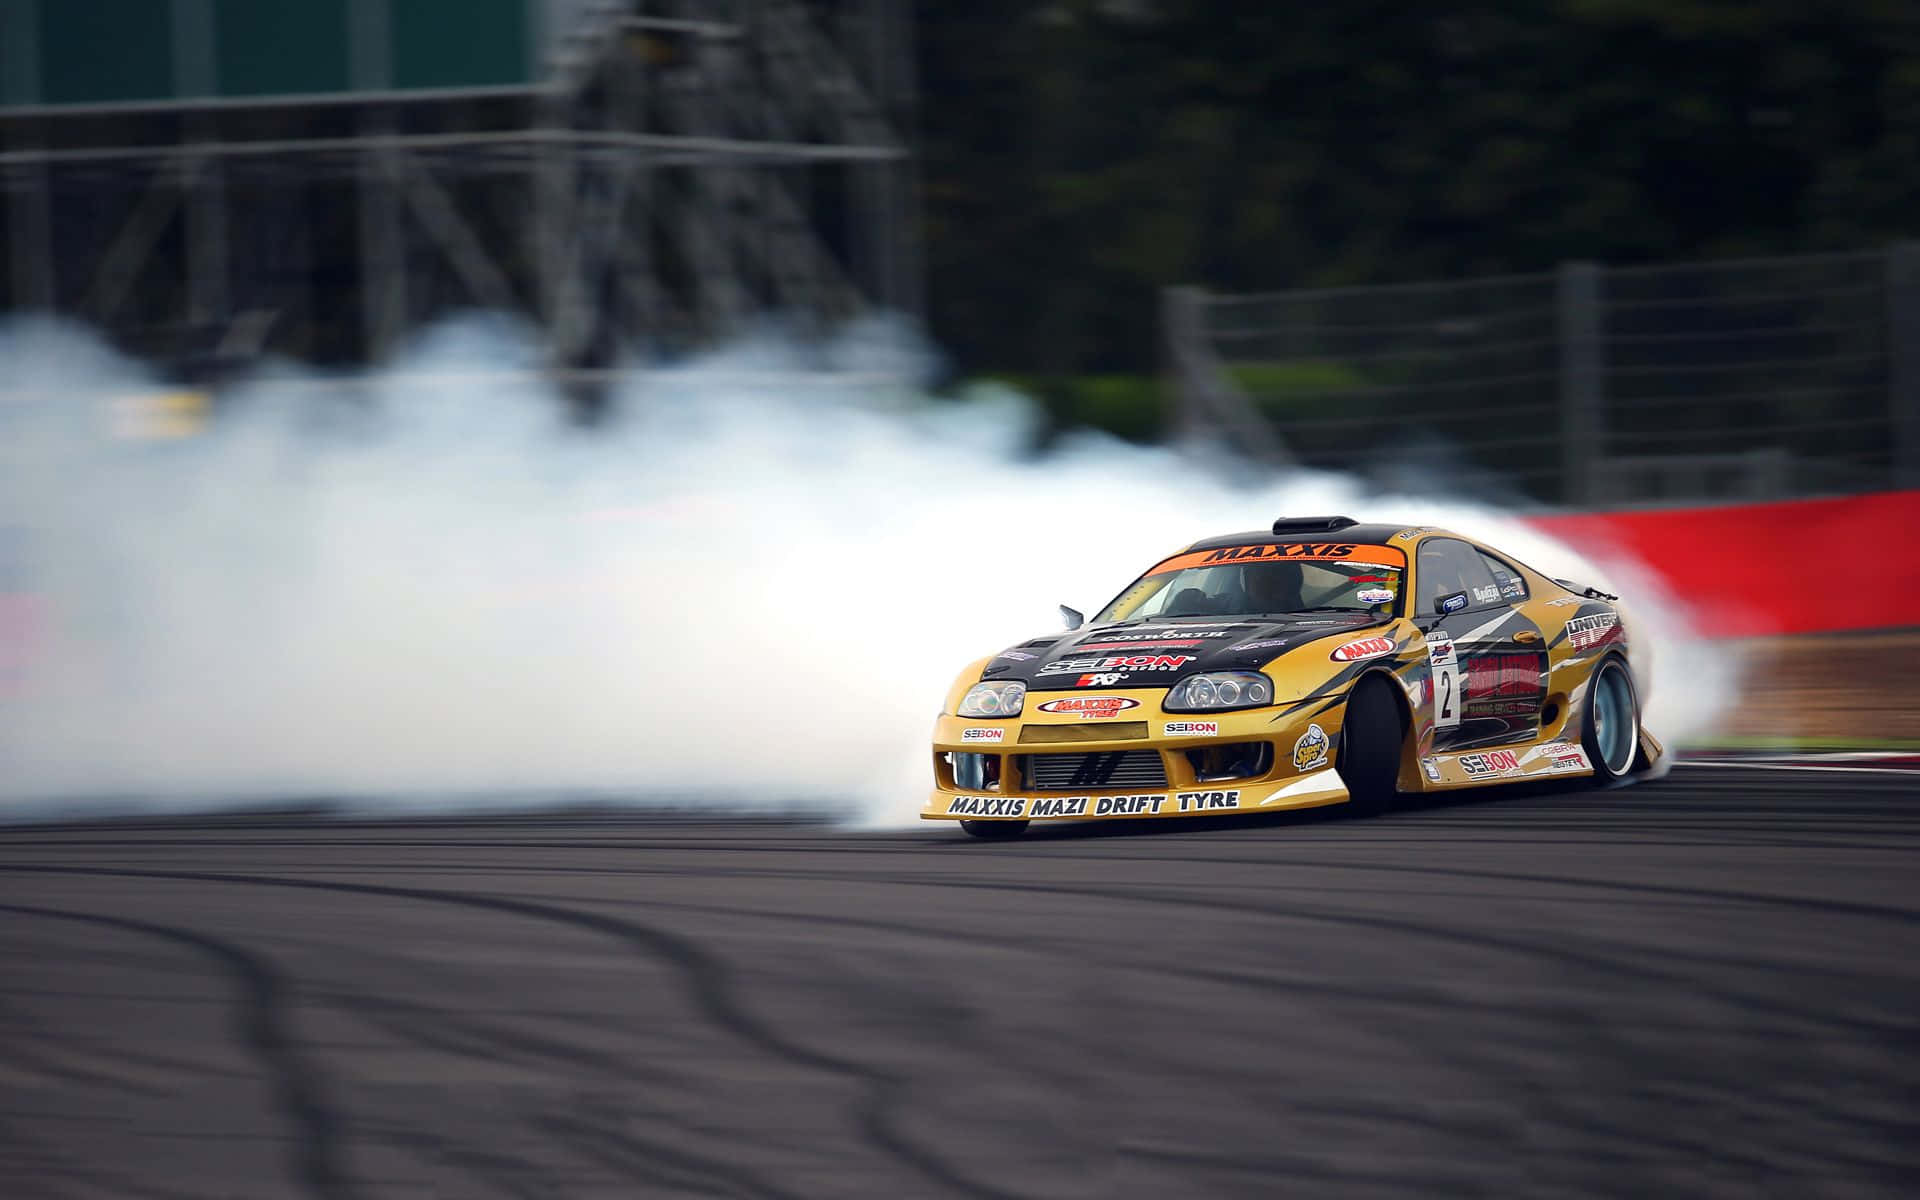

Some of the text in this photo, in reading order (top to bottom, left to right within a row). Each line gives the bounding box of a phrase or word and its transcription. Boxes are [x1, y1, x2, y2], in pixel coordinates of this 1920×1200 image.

[1202, 544, 1356, 563] MAXXIS
[1101, 630, 1228, 641] COSWORTH
[1440, 670, 1452, 720] 2
[1054, 698, 1123, 711] MAXXIS
[963, 729, 1002, 739] SEIBON
[1165, 723, 1216, 732] SEIBON
[949, 791, 1239, 816] MAXXIS MAZI DRIFT TYRE
